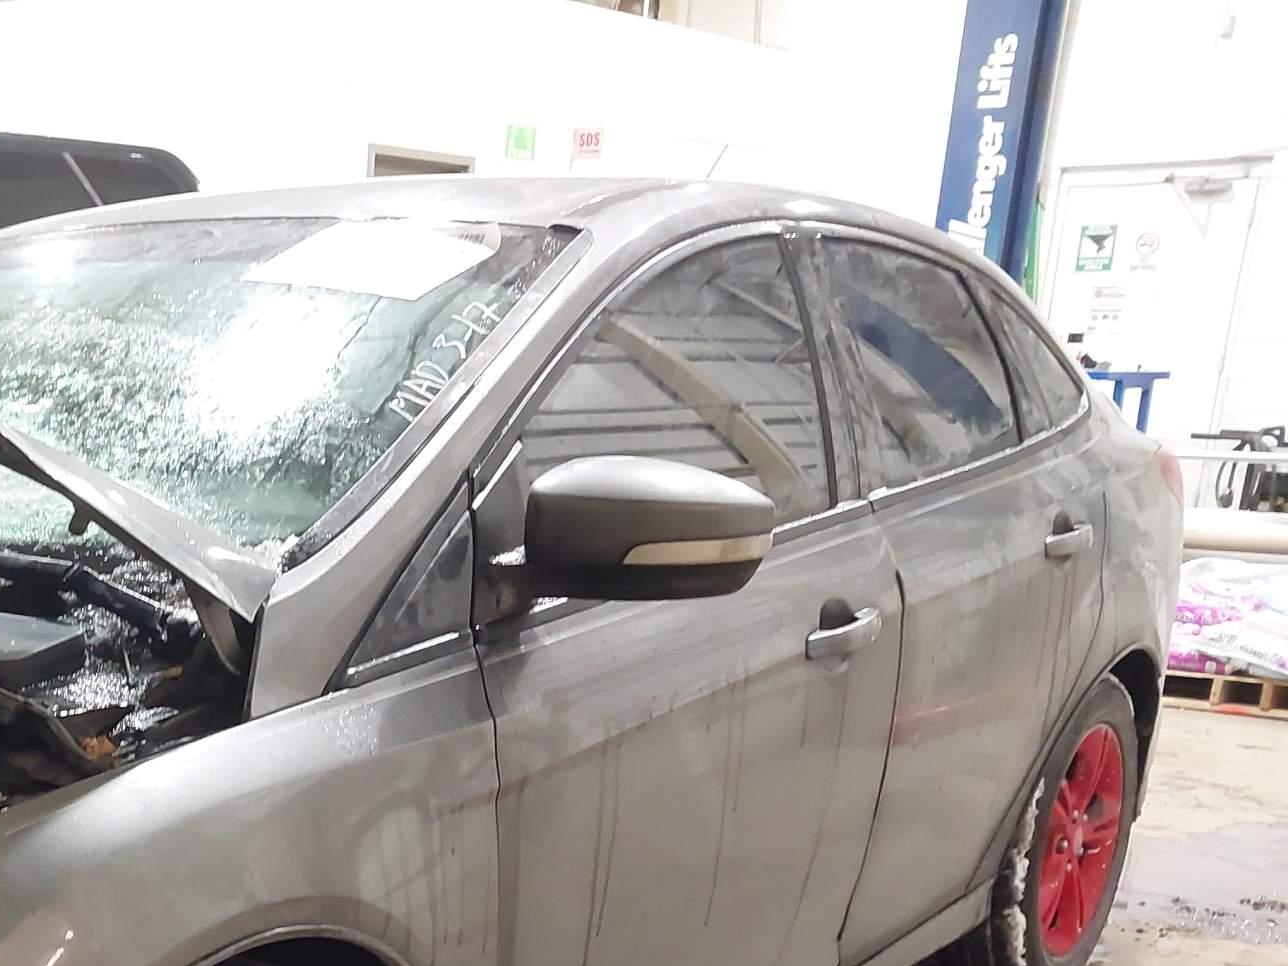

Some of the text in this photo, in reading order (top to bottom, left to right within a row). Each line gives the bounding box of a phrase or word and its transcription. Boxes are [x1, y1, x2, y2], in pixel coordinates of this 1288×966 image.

[977, 33, 1018, 109] Lifts
[578, 131, 601, 148] SDS
[432, 301, 501, 360] 3-17
